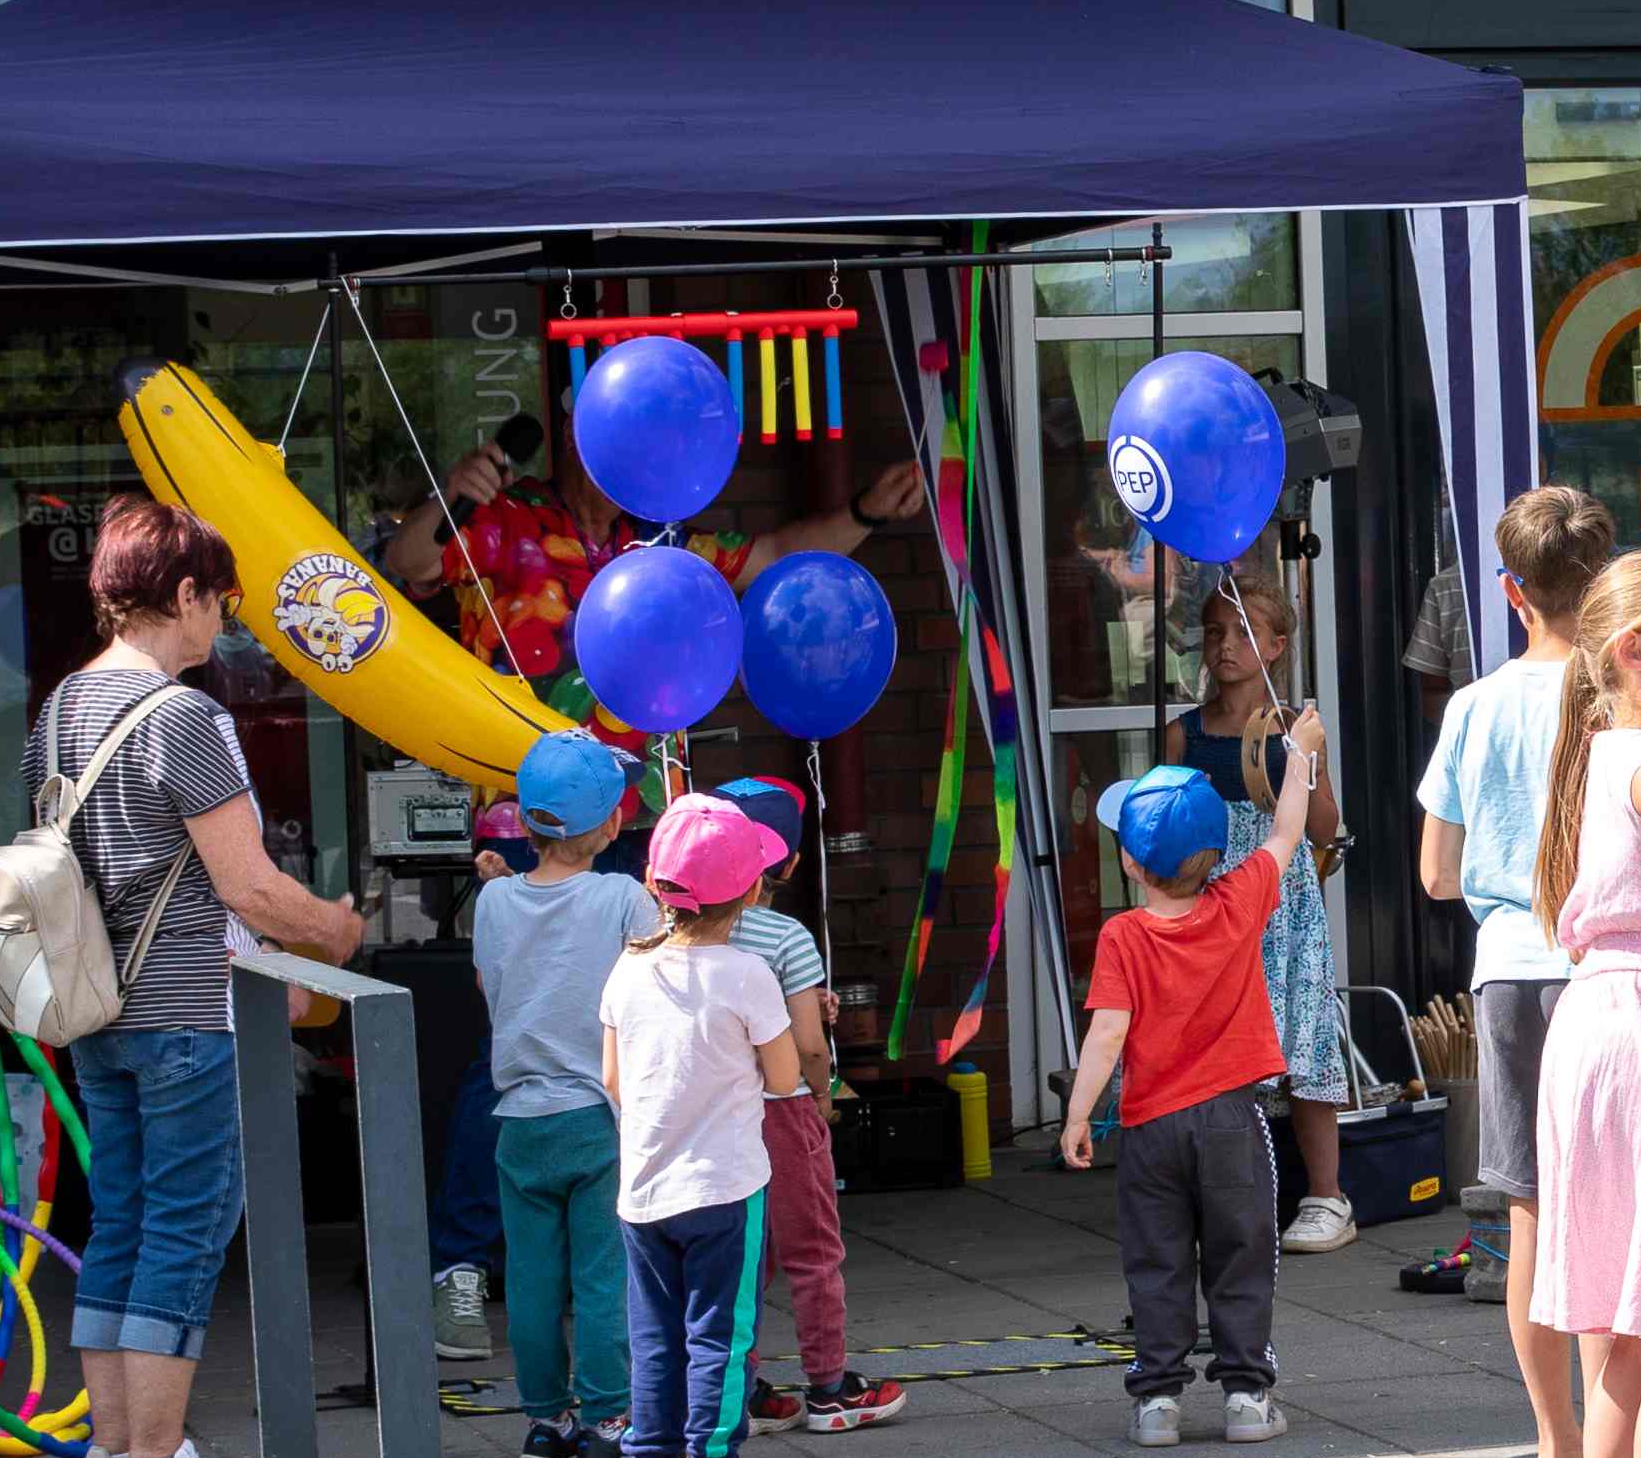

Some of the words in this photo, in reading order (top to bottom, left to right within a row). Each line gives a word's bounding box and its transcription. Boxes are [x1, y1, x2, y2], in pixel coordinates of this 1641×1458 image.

[1117, 470, 1154, 493] PEP
[277, 554, 373, 601] BANANAS
[322, 653, 354, 673] GO
